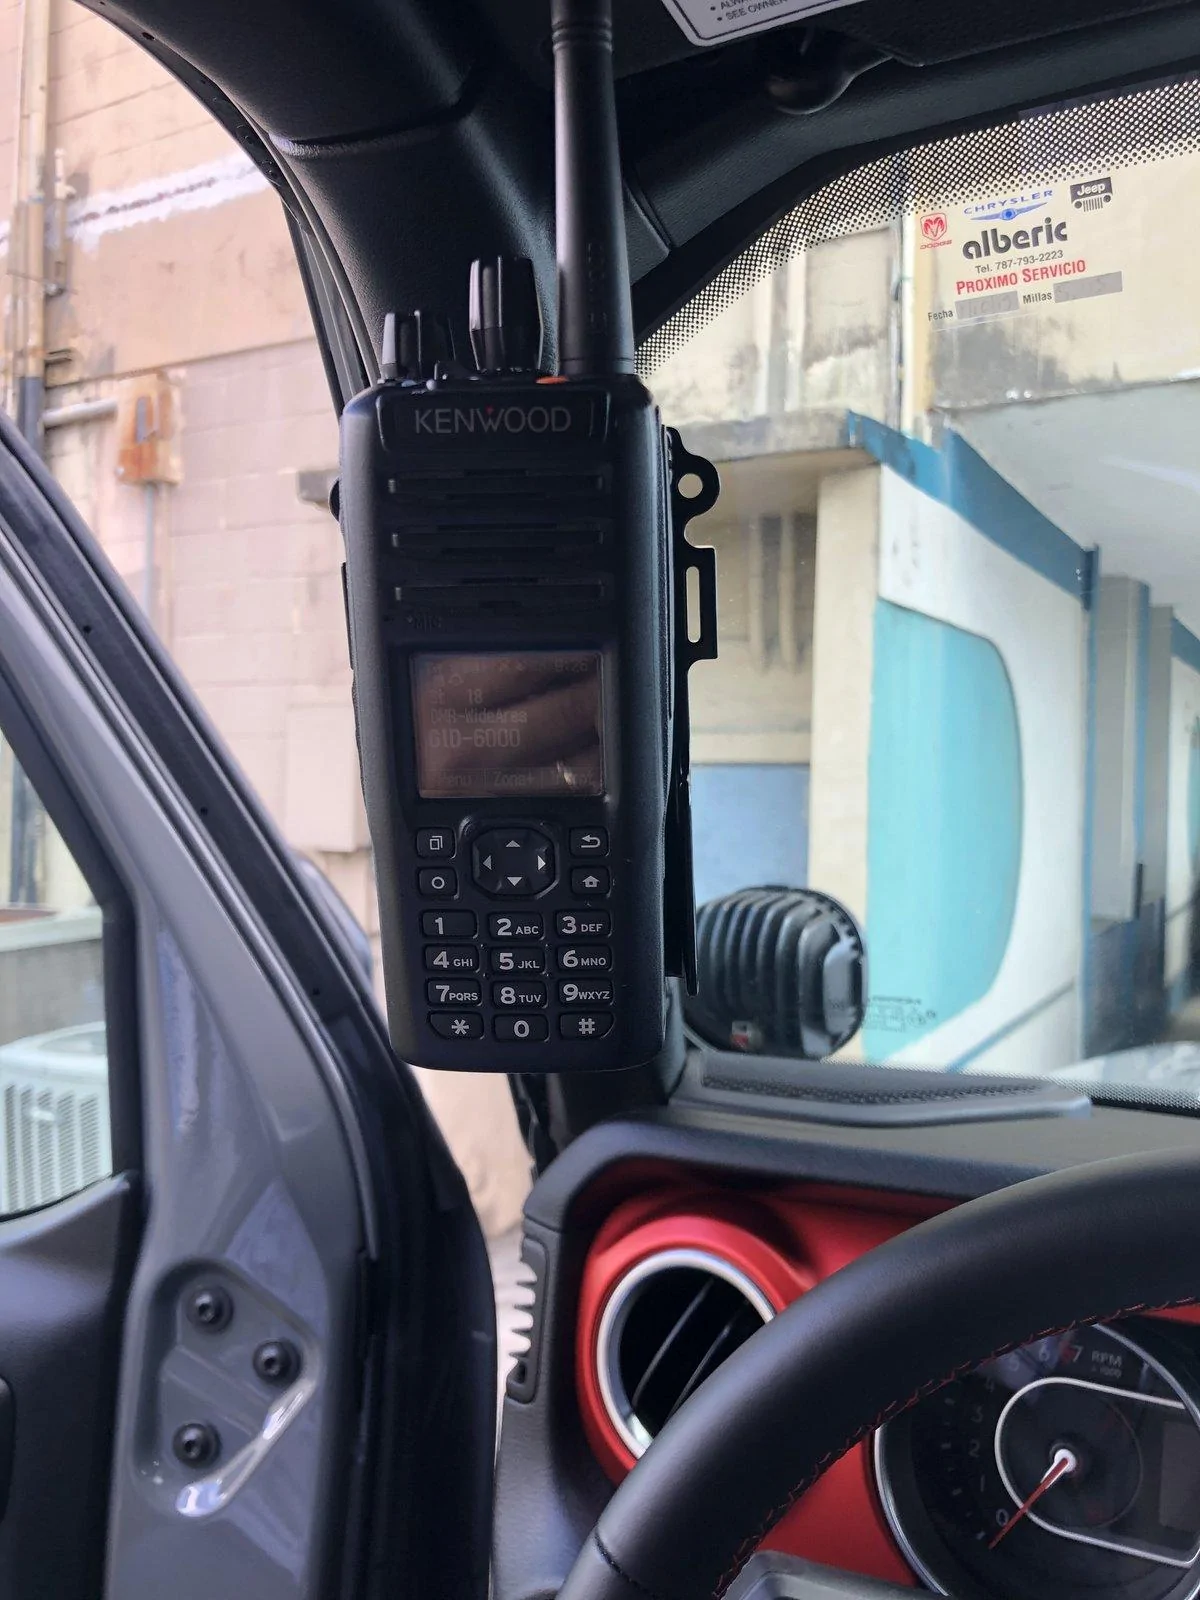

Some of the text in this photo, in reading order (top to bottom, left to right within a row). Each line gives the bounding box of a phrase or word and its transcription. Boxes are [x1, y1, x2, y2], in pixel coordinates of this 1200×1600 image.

[725, 8, 747, 21] SEE
[1077, 181, 1106, 197] Jeep
[963, 190, 1053, 215] CHRYSLER
[962, 217, 1068, 260] alberic
[975, 250, 1064, 274] Tel. 787-793-2223
[956, 259, 1087, 295] PROXIMO SERVICIO
[1022, 291, 1053, 304] Millas
[927, 309, 954, 321] Fecha
[415, 407, 571, 433] KENWOOD
[467, 688, 483, 705] 18
[435, 917, 444, 935] 1
[497, 918, 539, 936] 2 ABC
[562, 916, 603, 934] 3 DEF
[433, 951, 473, 968] 4 GHI
[499, 953, 540, 970] 5 JKL
[562, 950, 606, 968] 6 MNO
[435, 985, 478, 1002] 7 PQRS
[500, 987, 542, 1005] 8 TUV
[562, 984, 610, 1001] 9 WXYZ
[513, 1020, 530, 1038] 0
[1039, 1347, 1050, 1361] 6
[1070, 1345, 1084, 1363] 7
[1091, 1350, 1122, 1367] RPM
[971, 1405, 983, 1424] 3
[968, 1439, 981, 1458] 2
[980, 1474, 985, 1493] 1
[995, 1508, 1010, 1527] 0
